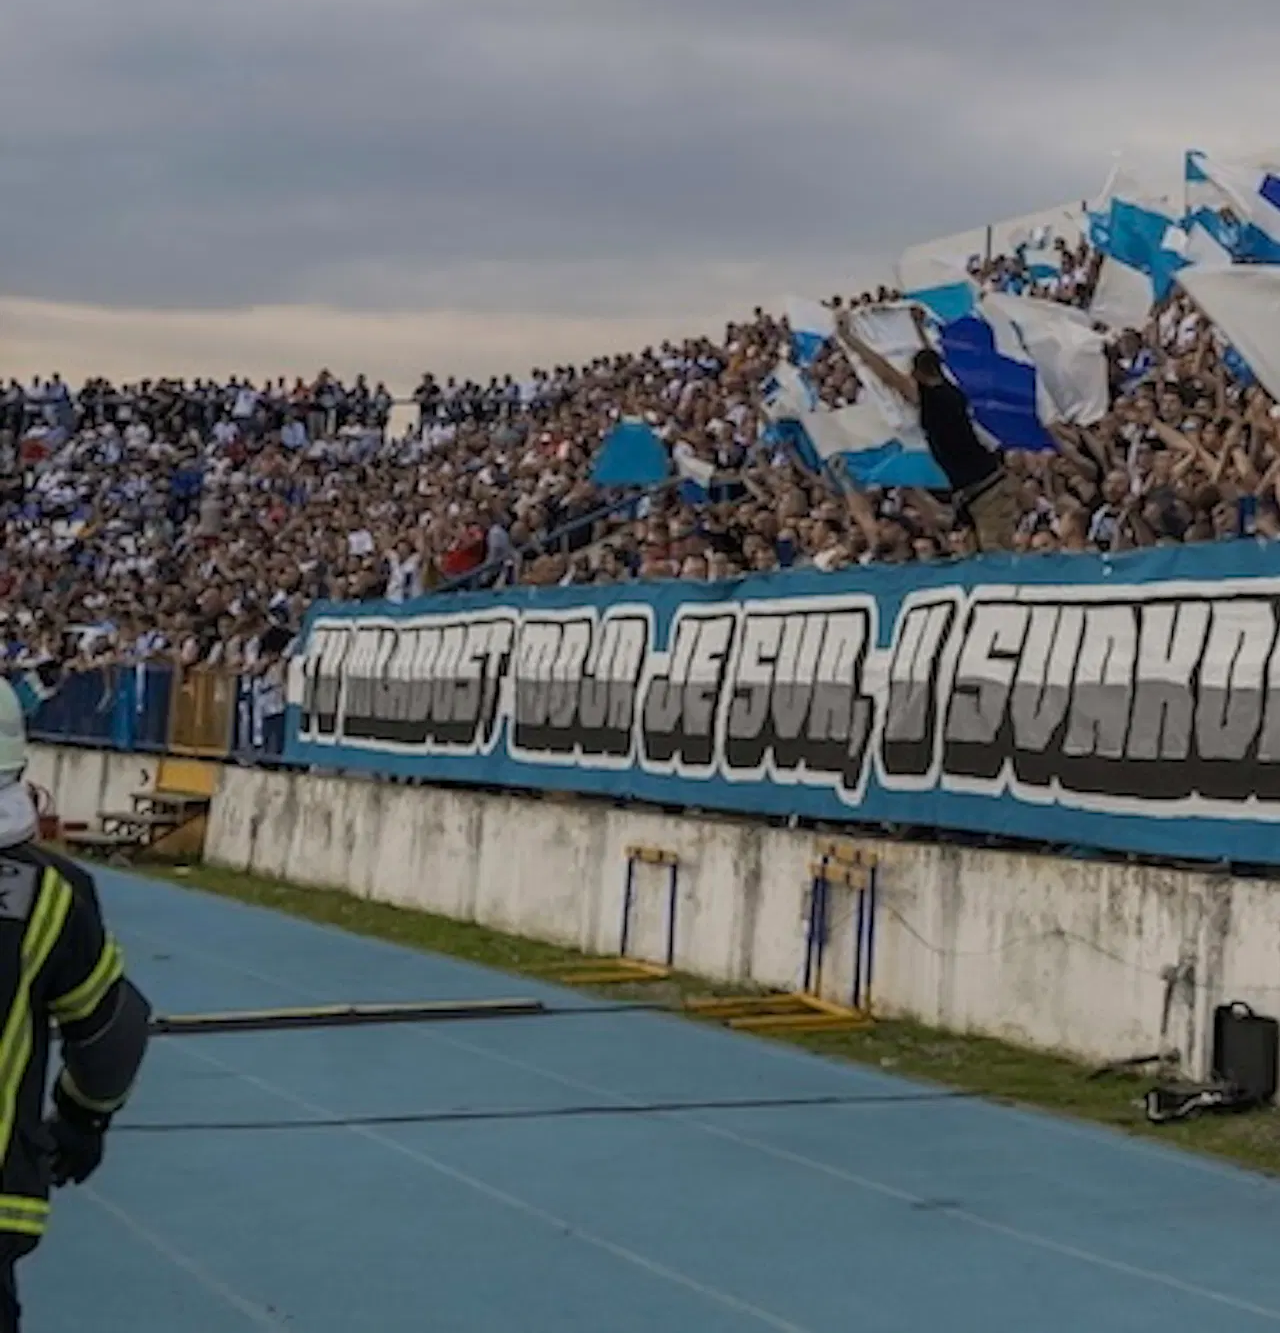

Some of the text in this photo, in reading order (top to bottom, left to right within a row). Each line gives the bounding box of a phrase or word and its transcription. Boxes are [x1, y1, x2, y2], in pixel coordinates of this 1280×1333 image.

[300, 624, 345, 733] TU
[641, 613, 736, 766] JE
[882, 600, 956, 775] U
